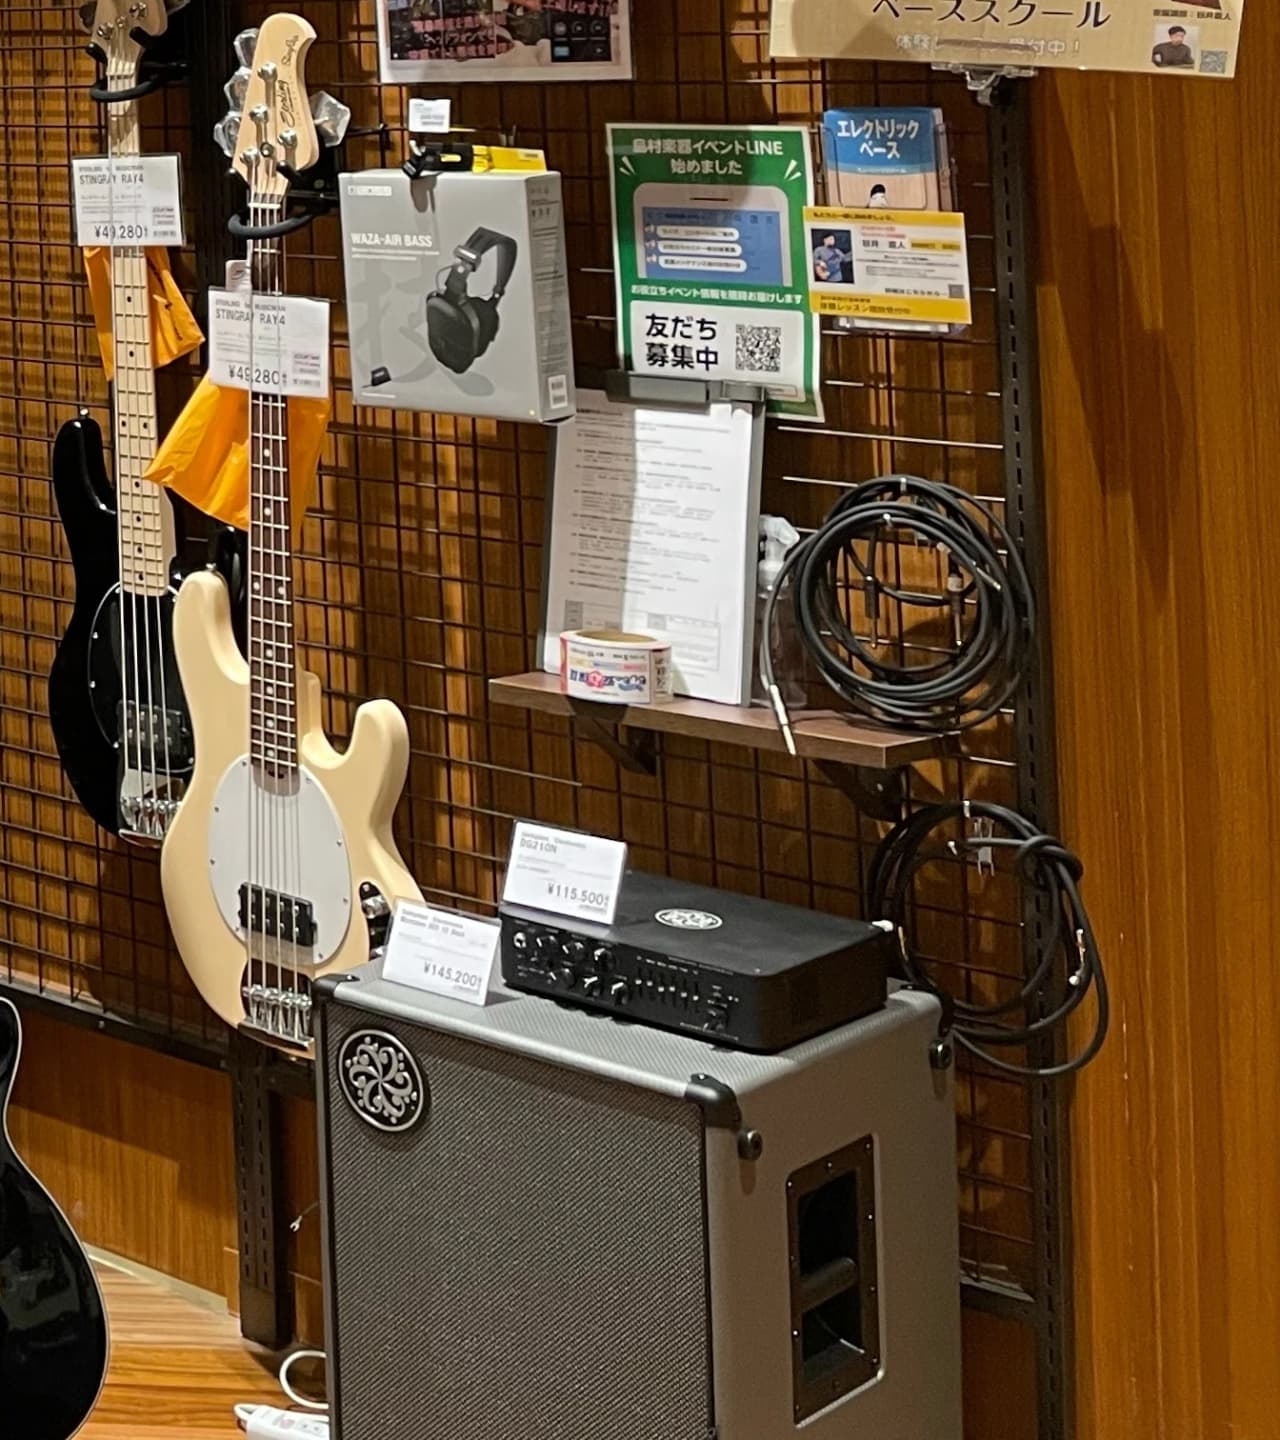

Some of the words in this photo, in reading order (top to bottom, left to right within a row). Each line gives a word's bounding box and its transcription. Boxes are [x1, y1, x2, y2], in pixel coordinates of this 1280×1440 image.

[837, 119, 920, 140] エレクトリック
[860, 141, 900, 160] ベース
[670, 158, 743, 176] 始めました
[351, 232, 402, 247] WAZA-AIR
[404, 233, 433, 248] BASS
[645, 313, 718, 341] 友だち
[646, 344, 719, 372] 募集中
